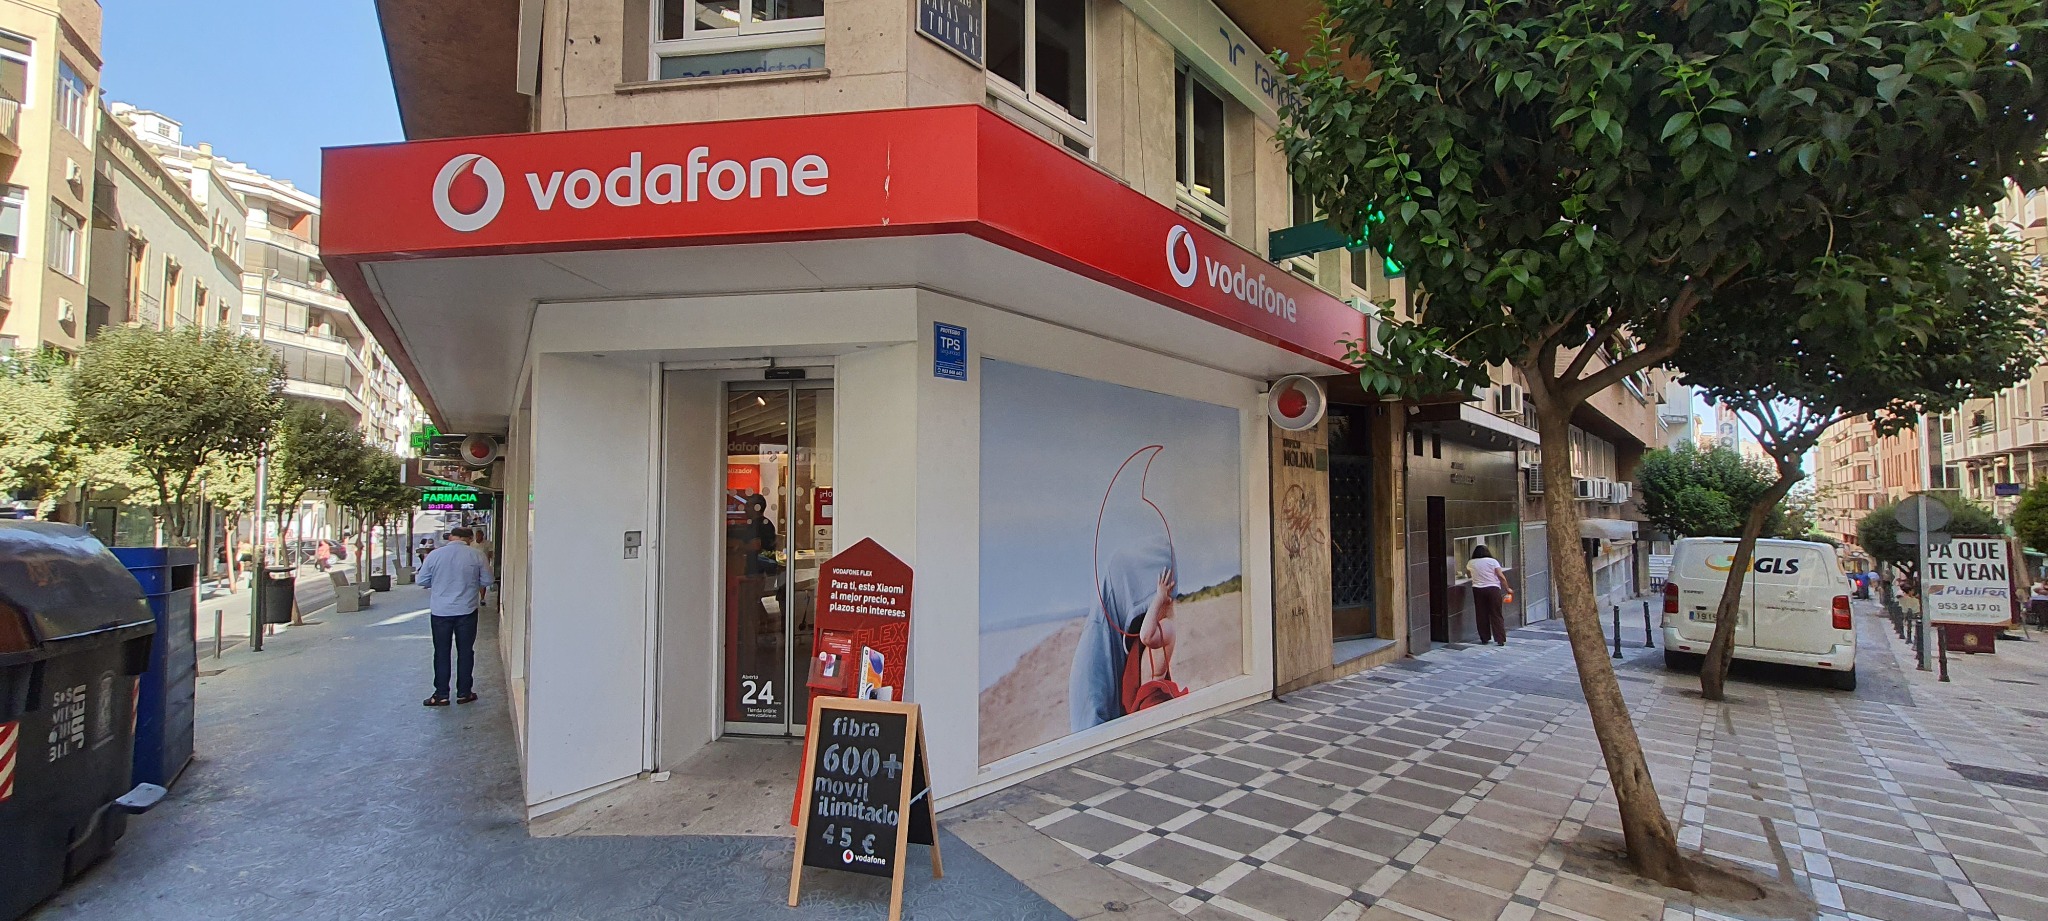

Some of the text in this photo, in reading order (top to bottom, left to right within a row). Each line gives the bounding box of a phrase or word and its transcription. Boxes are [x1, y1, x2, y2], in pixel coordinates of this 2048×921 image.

[928, 11, 976, 56] TOLOSA
[525, 146, 829, 211] vodafone
[1205, 255, 1297, 325] vodafone
[940, 336, 960, 351] TPS
[1283, 449, 1314, 469] MOLINA
[423, 494, 477, 502] FARMACIA
[1927, 541, 2000, 561] PA QUE
[832, 568, 873, 577] VODAFONE FLEX
[1754, 557, 1799, 574] GLS
[1928, 563, 2006, 581] TE VEAN
[831, 579, 904, 594] Para ti, este Xiaomi
[830, 591, 838, 600] al
[839, 592, 862, 603] mejor
[863, 595, 889, 605] precio,
[1938, 603, 2001, 613] 953 24 17 01
[829, 602, 906, 618] plazos sin intereses
[855, 622, 907, 648] FLEX
[742, 680, 774, 705] 24
[832, 716, 880, 737] fibra
[823, 743, 902, 779] 600+
[815, 776, 869, 802] movil
[817, 796, 900, 827] ilimitado
[854, 853, 886, 866] vodafone
